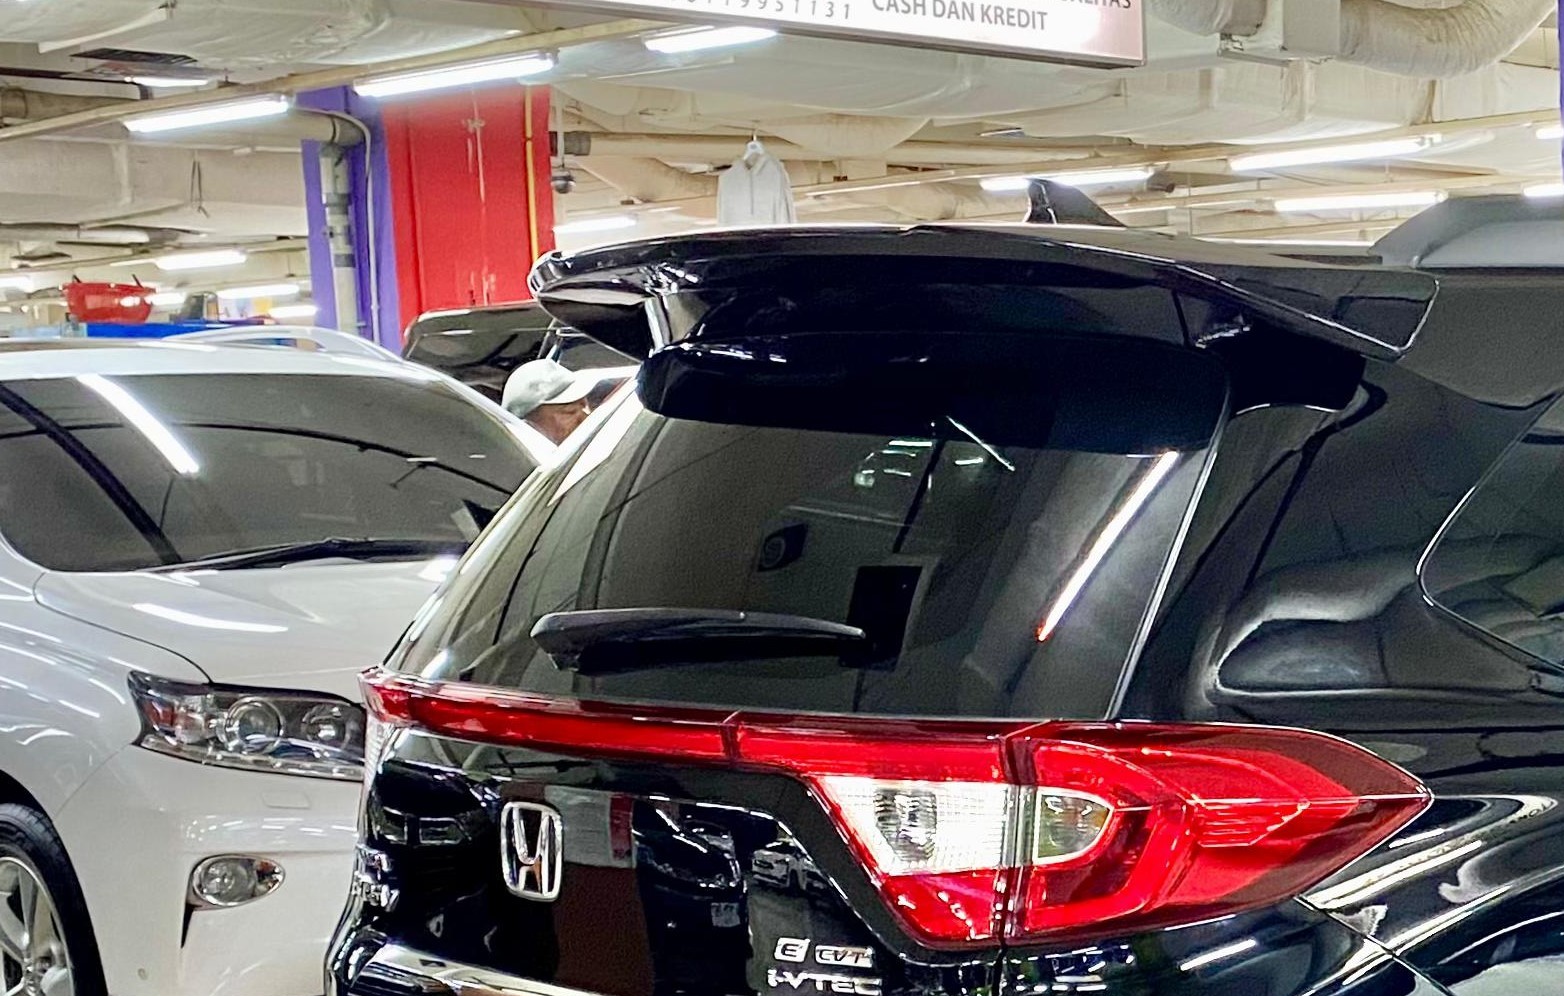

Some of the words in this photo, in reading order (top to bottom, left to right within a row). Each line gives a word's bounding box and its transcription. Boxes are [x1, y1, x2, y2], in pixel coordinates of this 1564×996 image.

[872, 0, 927, 16] CASH
[932, 0, 975, 22] DAN
[981, 3, 1048, 31] KREDIT
[817, 947, 870, 966] CVT
